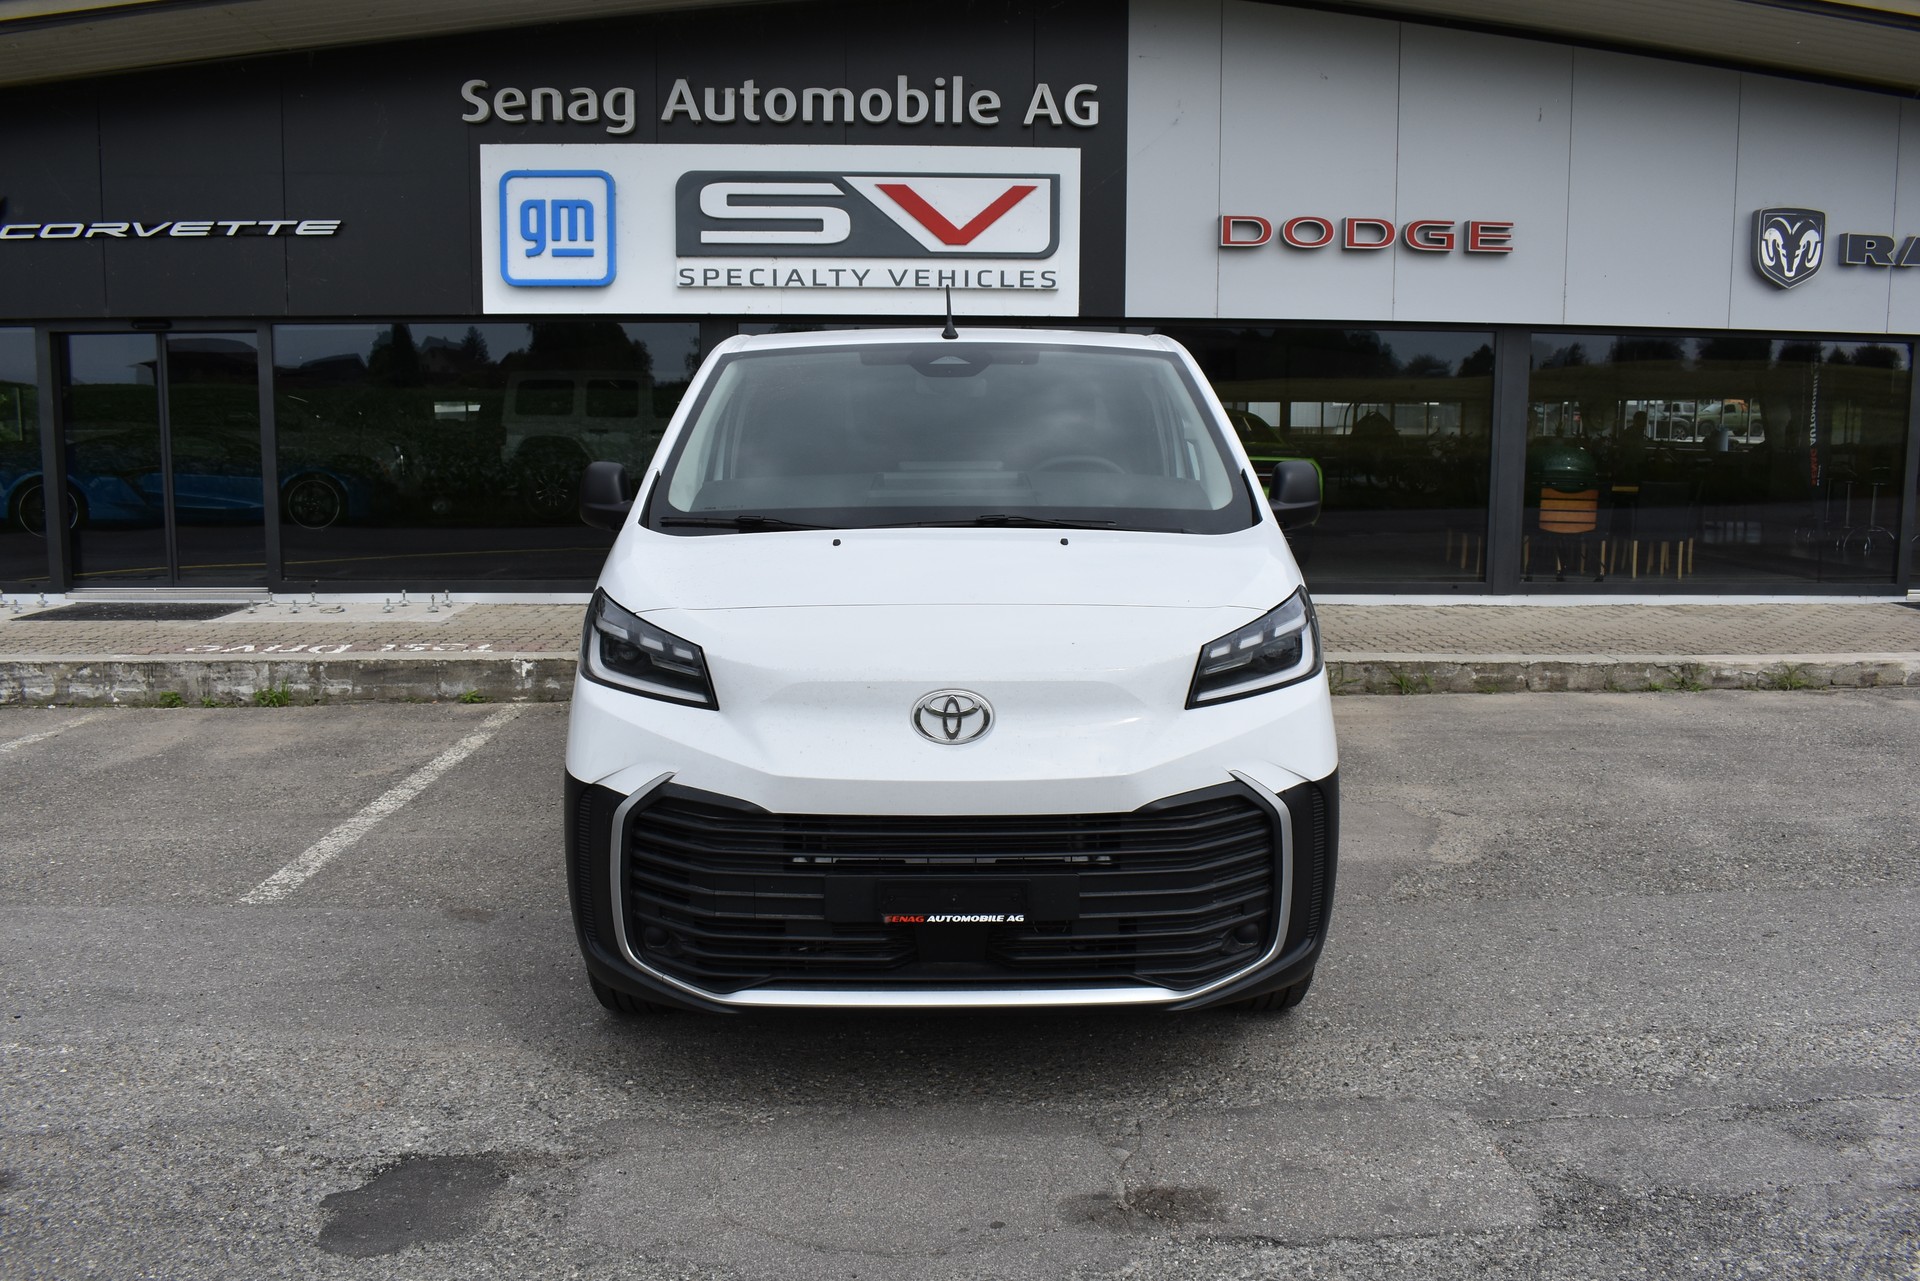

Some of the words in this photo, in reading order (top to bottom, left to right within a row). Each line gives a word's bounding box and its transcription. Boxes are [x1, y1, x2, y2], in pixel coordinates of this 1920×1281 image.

[461, 79, 638, 135] Senag
[660, 74, 1001, 126] Automobile
[1022, 83, 1100, 128] AG
[0, 219, 342, 240] CORVETTE
[520, 199, 594, 257] gm
[1218, 214, 1515, 253] DODGE
[678, 267, 871, 288] SPECIALTY
[887, 268, 1058, 289] VEHICLES
[184, 643, 353, 654] Drive
[926, 914, 1005, 923] AUTOMOBILE
[1006, 914, 1025, 923] AG
